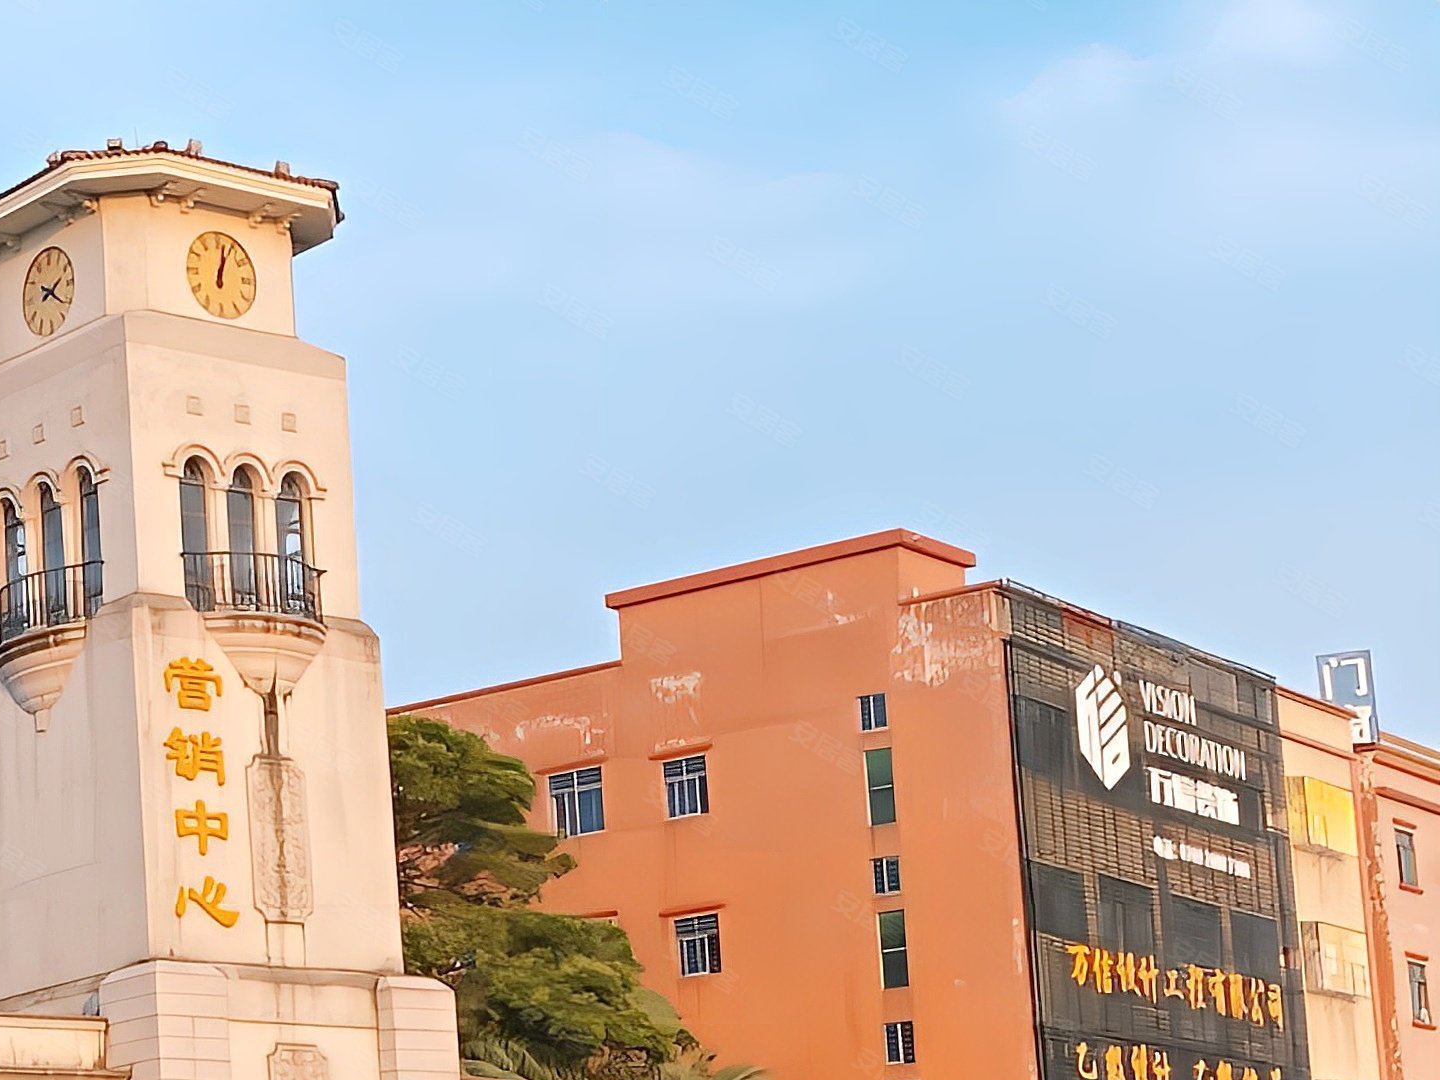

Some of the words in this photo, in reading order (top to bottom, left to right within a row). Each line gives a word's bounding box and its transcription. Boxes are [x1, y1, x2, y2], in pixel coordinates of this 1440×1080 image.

[1138, 679, 1198, 726] VISION
[1143, 720, 1248, 781] DECORATION
[162, 656, 240, 929] 营销中心
